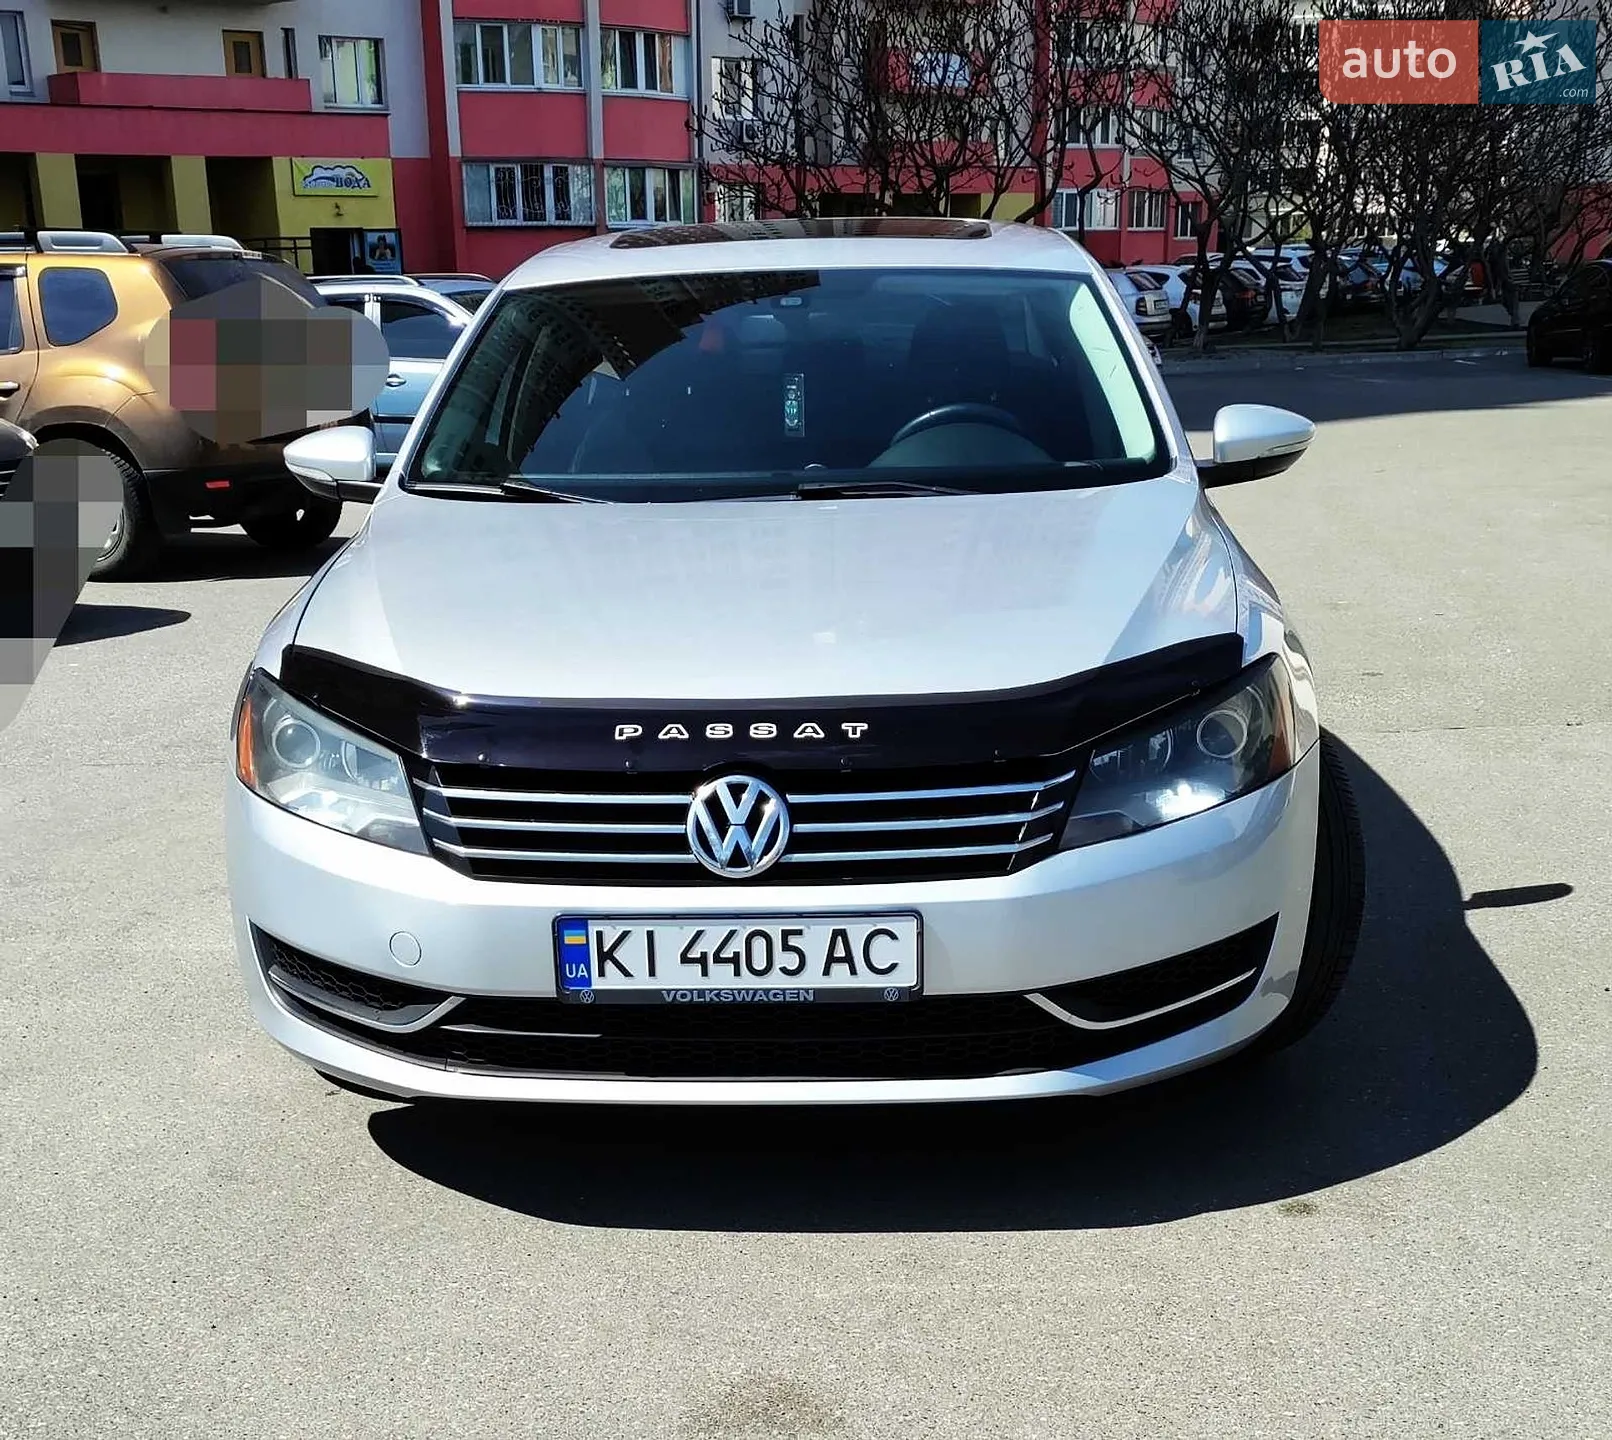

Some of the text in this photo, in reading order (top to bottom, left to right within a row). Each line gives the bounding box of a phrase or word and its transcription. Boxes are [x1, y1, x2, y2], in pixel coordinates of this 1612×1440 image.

[615, 722, 868, 740] PASSAT
[595, 927, 900, 978] KI 4405 AC
[565, 962, 589, 979] UA
[661, 988, 815, 1002] VOLKSWAGEN
